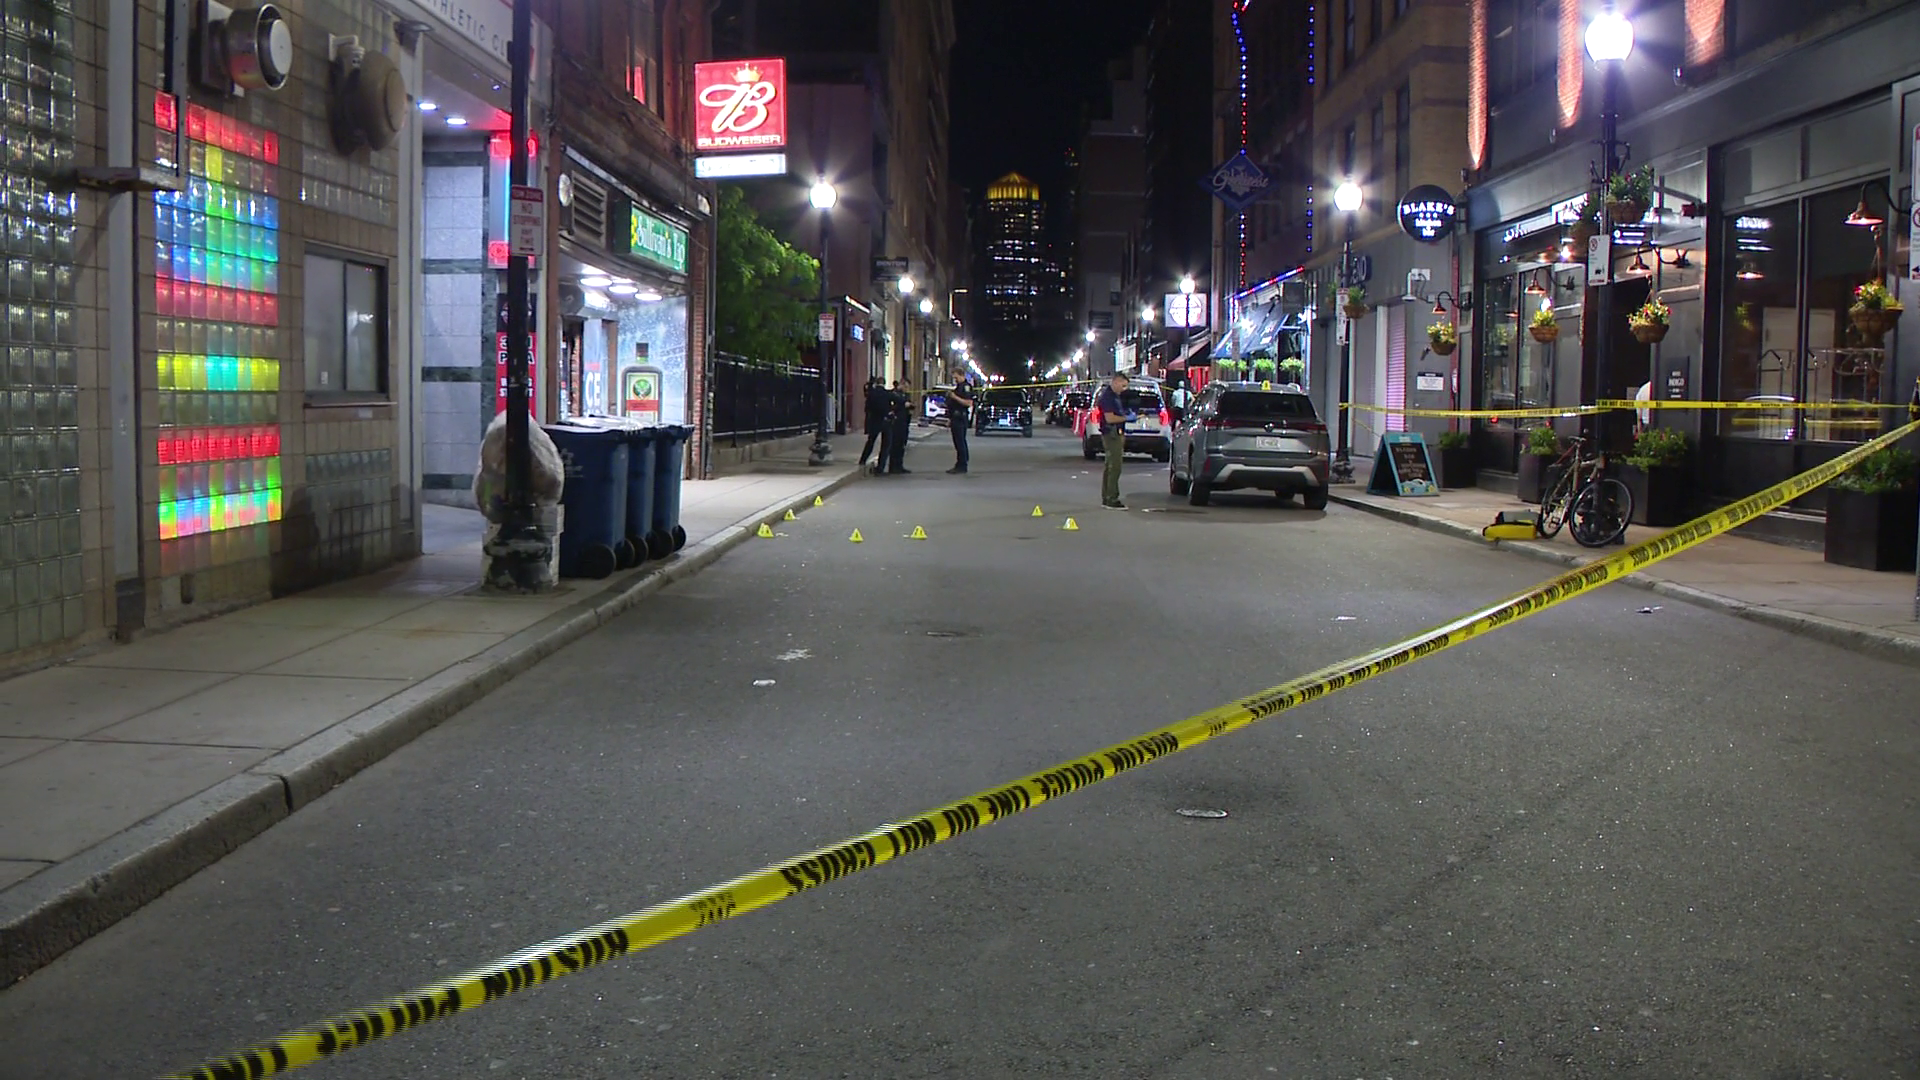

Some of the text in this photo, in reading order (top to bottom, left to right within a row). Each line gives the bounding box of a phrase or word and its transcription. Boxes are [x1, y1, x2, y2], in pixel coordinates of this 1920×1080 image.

[428, 0, 486, 41] HLETIC
[698, 135, 781, 147] BUDWEISER
[521, 203, 533, 214] NO
[1403, 202, 1454, 215] BLAKE'S
[637, 215, 685, 270] Sullivan's Tap
